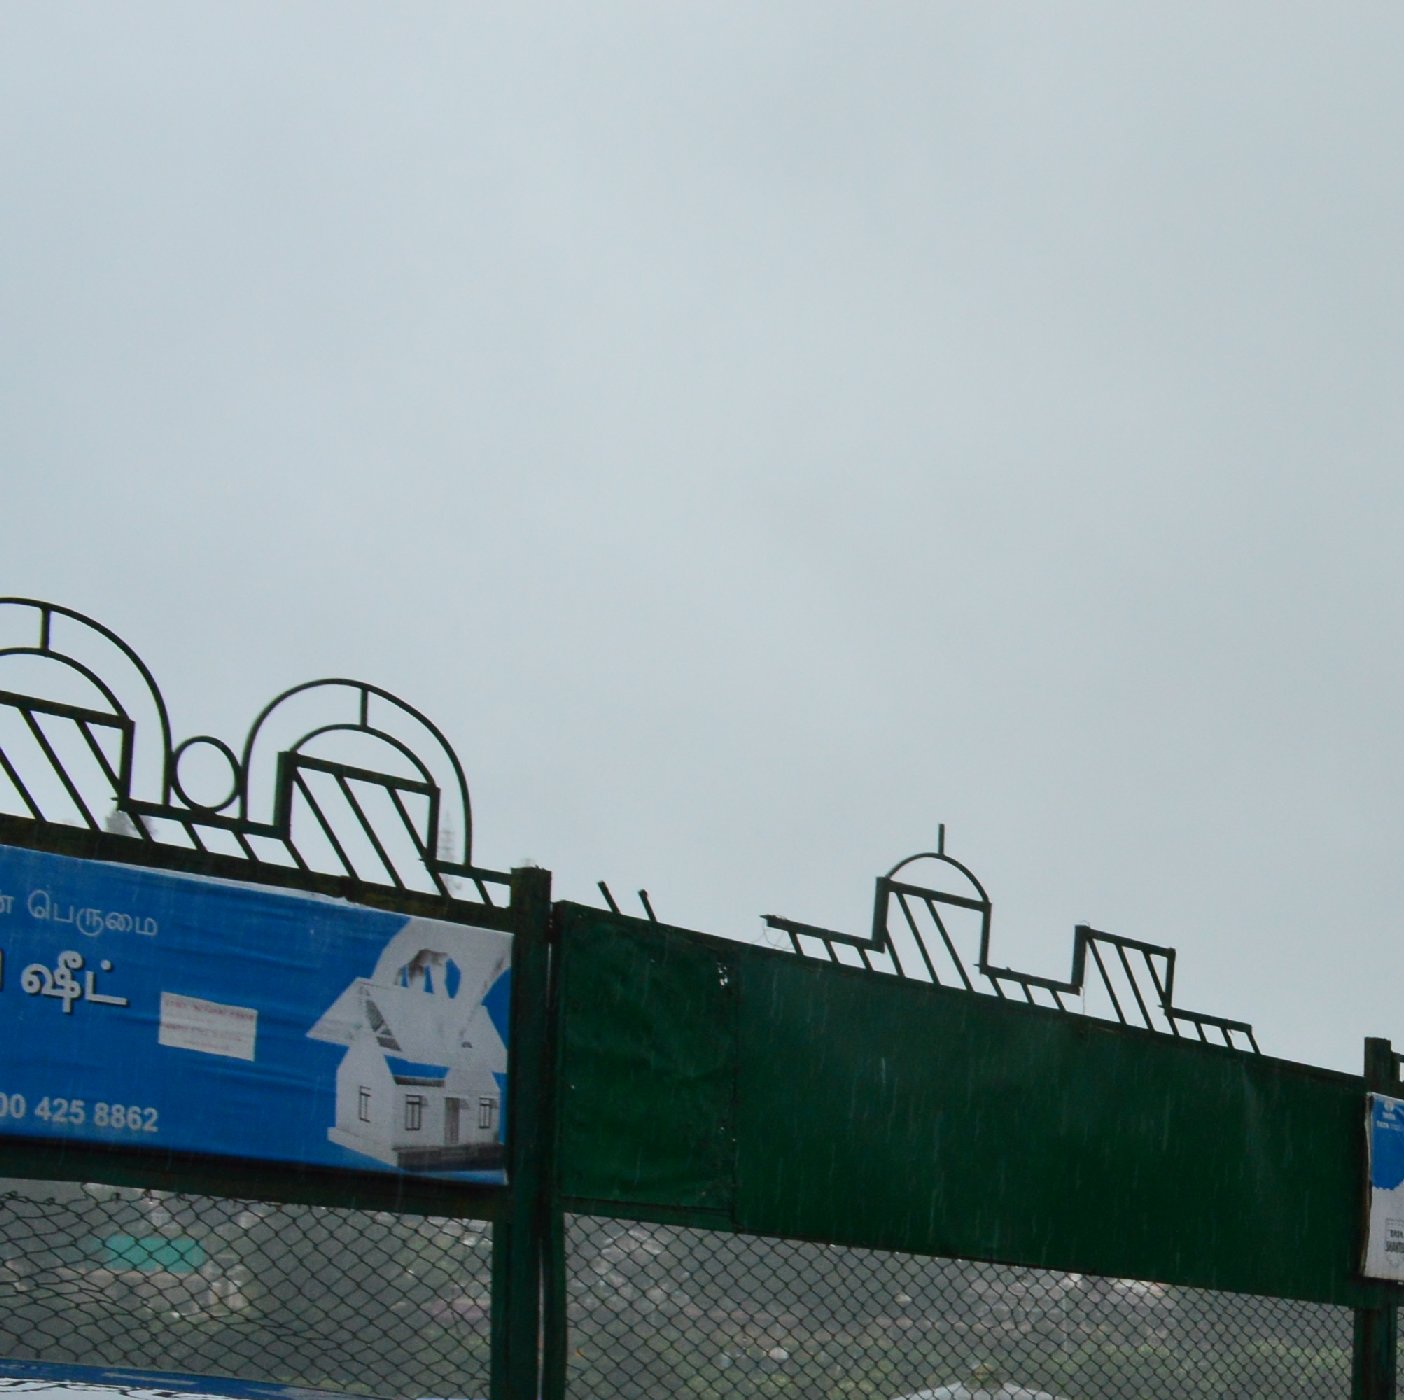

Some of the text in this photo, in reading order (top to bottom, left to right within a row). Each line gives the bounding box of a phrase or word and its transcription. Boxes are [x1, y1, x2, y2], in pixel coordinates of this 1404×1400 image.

[28, 889, 158, 937] பெருமை
[21, 950, 128, 1014] ஷீட்
[35, 1096, 85, 1125] 425
[94, 1102, 159, 1132] 8862
